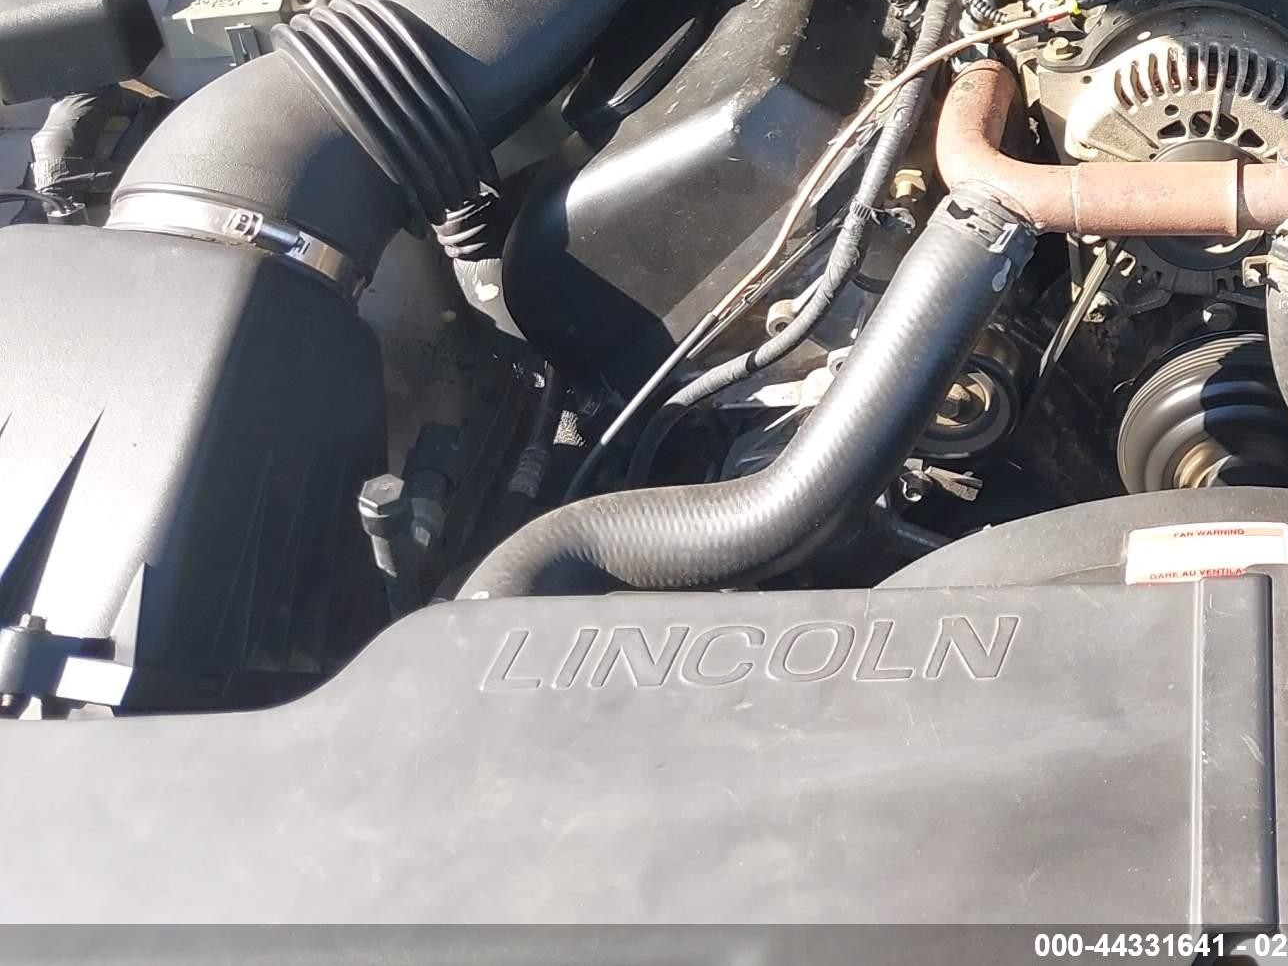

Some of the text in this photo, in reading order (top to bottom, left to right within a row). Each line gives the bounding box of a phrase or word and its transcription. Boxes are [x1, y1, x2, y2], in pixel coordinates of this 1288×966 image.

[1196, 528, 1245, 537] WARNING
[1149, 567, 1244, 580] GARE AU VENTILA
[480, 616, 1021, 691] LINCOLN
